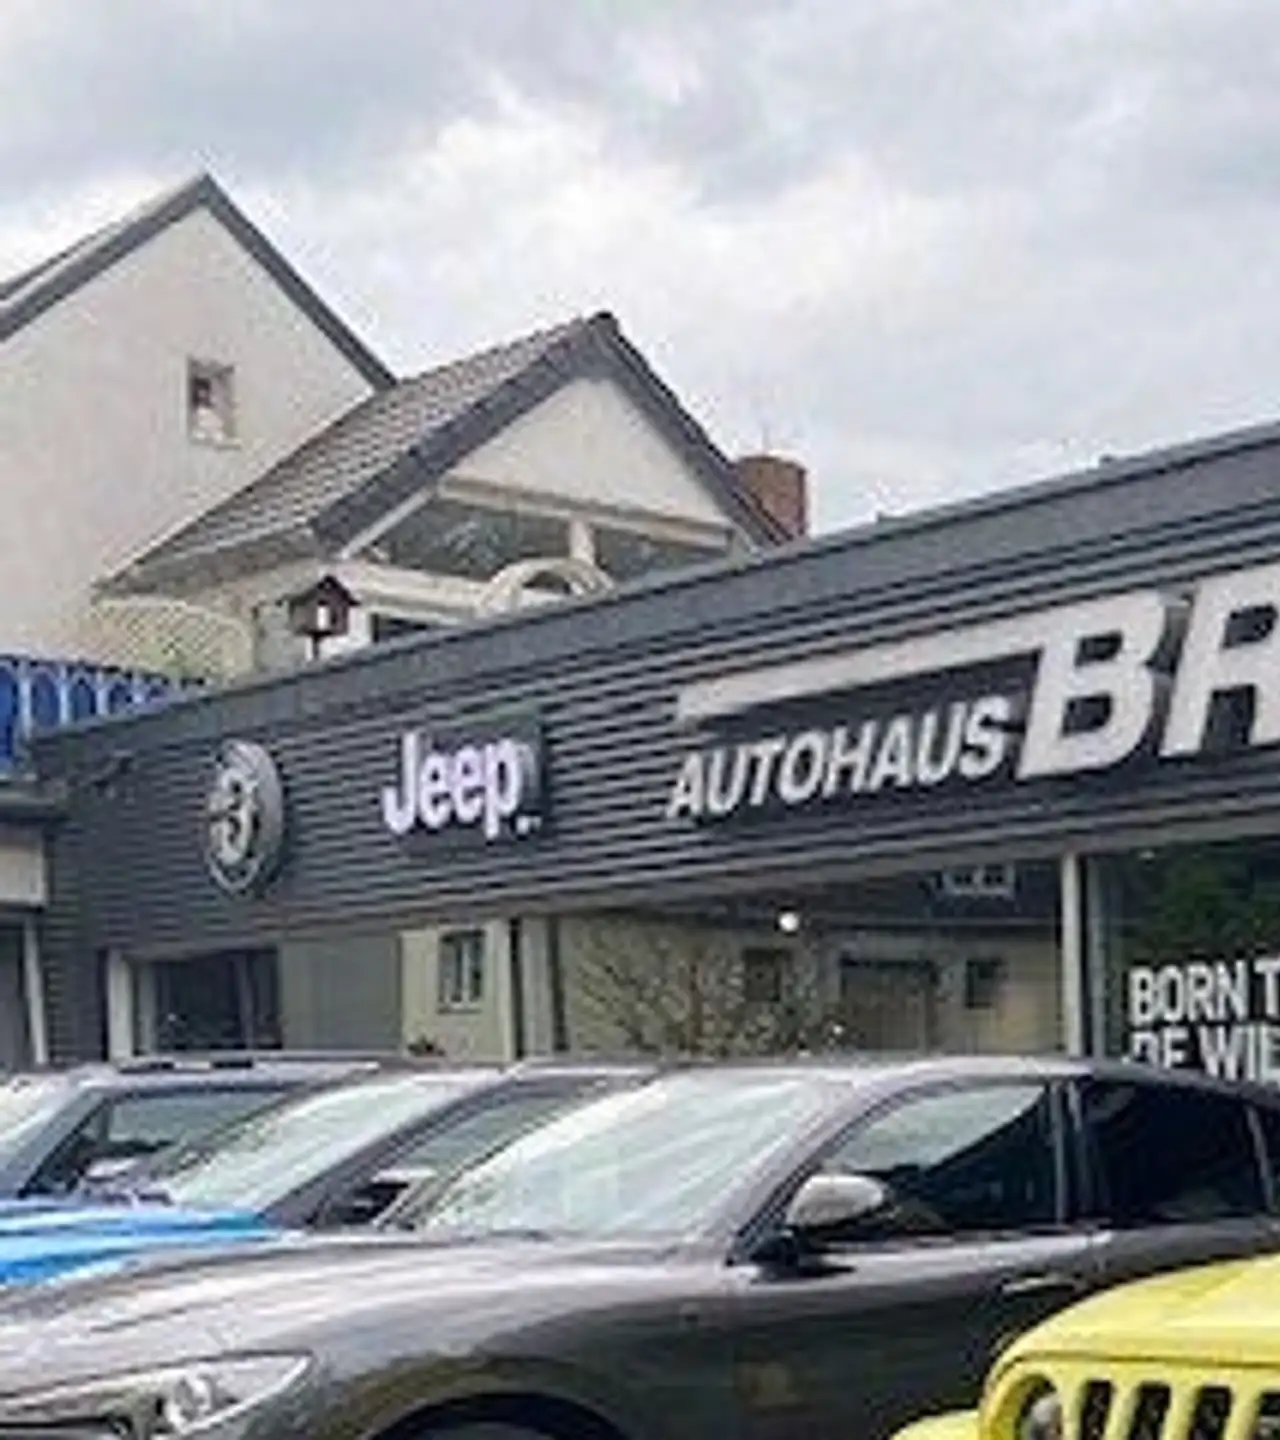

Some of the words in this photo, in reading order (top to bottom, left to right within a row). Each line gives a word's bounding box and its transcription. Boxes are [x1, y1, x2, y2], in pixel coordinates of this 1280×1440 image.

[382, 730, 525, 840] Jeep
[664, 692, 1016, 824] AUTOHAUS
[1128, 960, 1249, 1027] BORN
